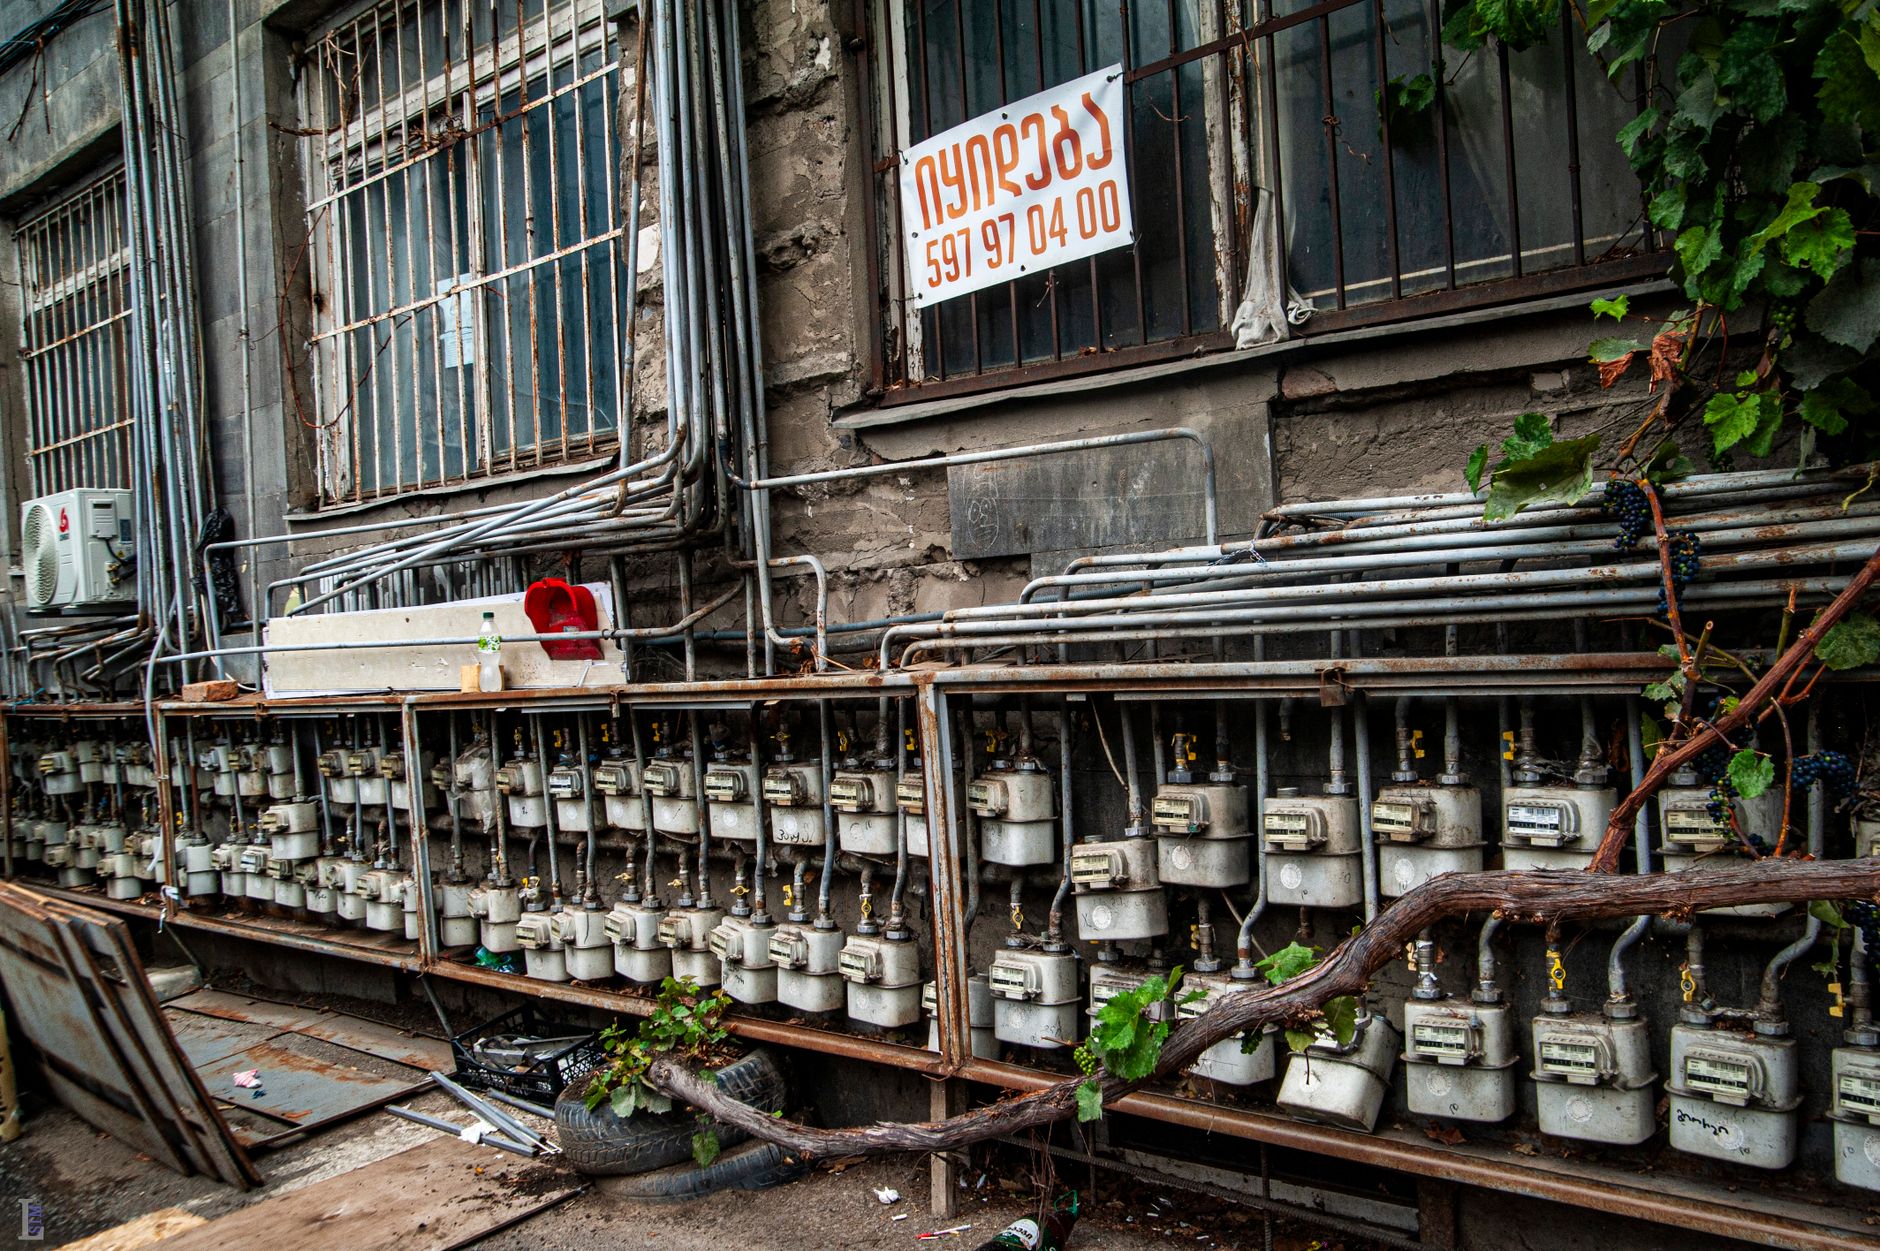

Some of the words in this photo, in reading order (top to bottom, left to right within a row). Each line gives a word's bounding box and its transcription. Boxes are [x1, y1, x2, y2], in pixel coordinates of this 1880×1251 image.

[915, 91, 1113, 231] იყიდება
[926, 227, 972, 288] 597
[981, 212, 1015, 269] 97
[1027, 196, 1068, 256] 04
[1076, 179, 1121, 240] 00
